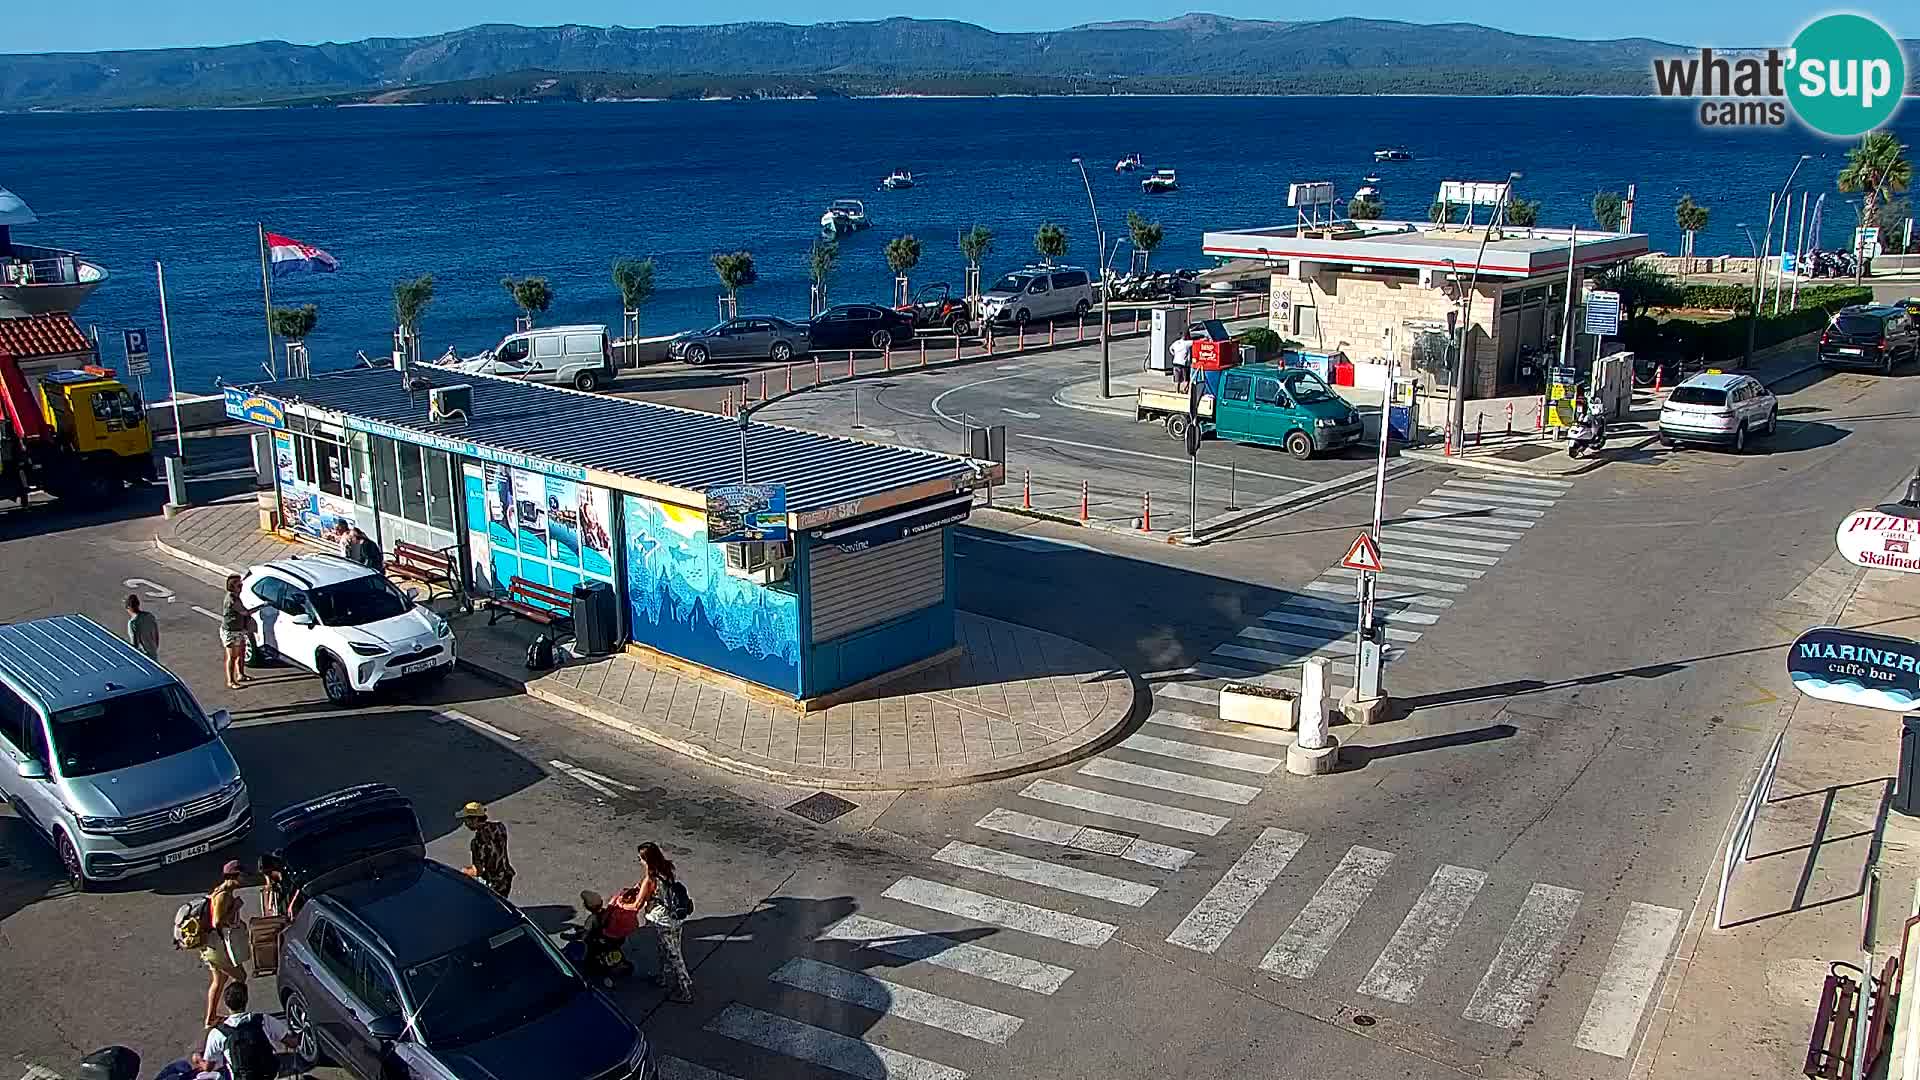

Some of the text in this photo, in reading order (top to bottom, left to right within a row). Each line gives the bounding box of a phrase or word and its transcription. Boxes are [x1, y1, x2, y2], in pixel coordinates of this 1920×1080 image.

[129, 333, 141, 351] P
[477, 446, 492, 459] BUS
[492, 450, 525, 466] STATION
[526, 458, 554, 473] TICKET
[554, 464, 582, 478] OFFICE
[837, 539, 869, 553] Novine
[1828, 663, 1896, 681] caffe bar
